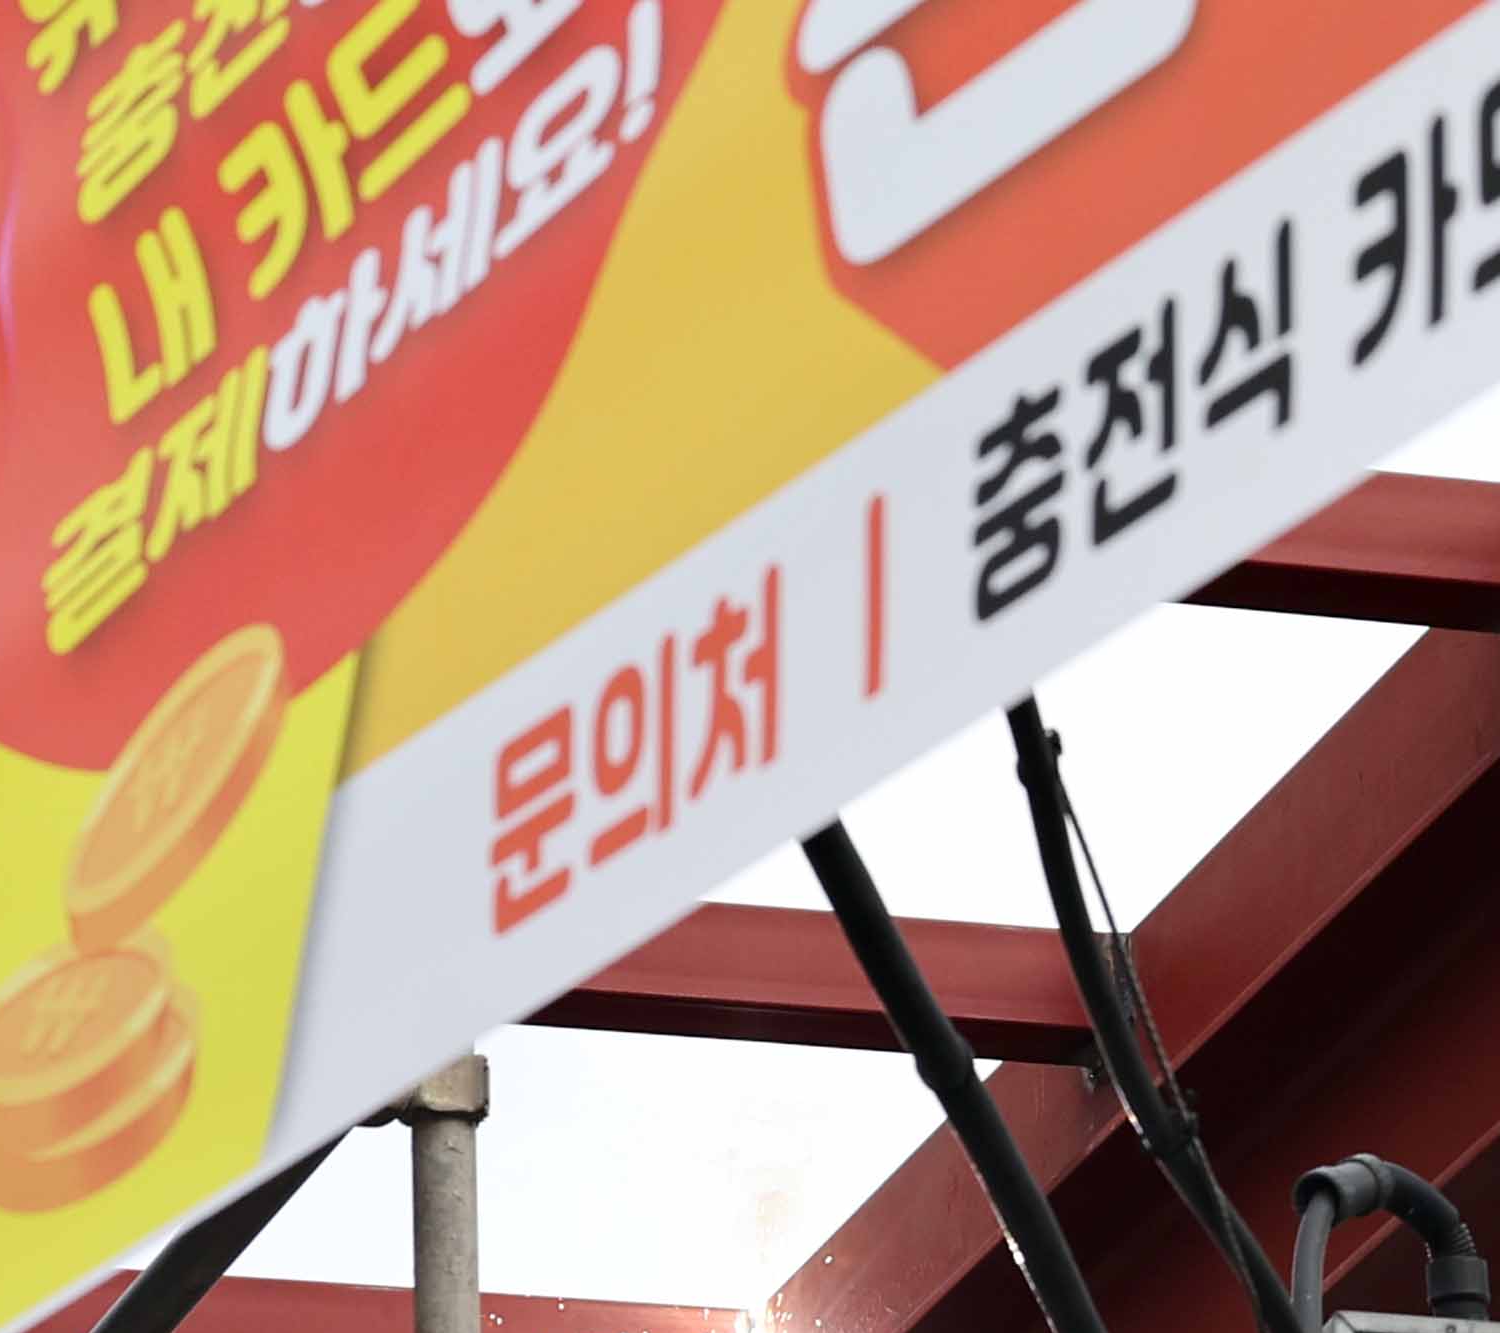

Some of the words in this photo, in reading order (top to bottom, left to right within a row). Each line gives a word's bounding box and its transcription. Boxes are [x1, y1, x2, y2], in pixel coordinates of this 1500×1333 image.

[88, 206, 216, 425] 내
[488, 562, 782, 938] 문의처
[970, 214, 1296, 622] 충전식
